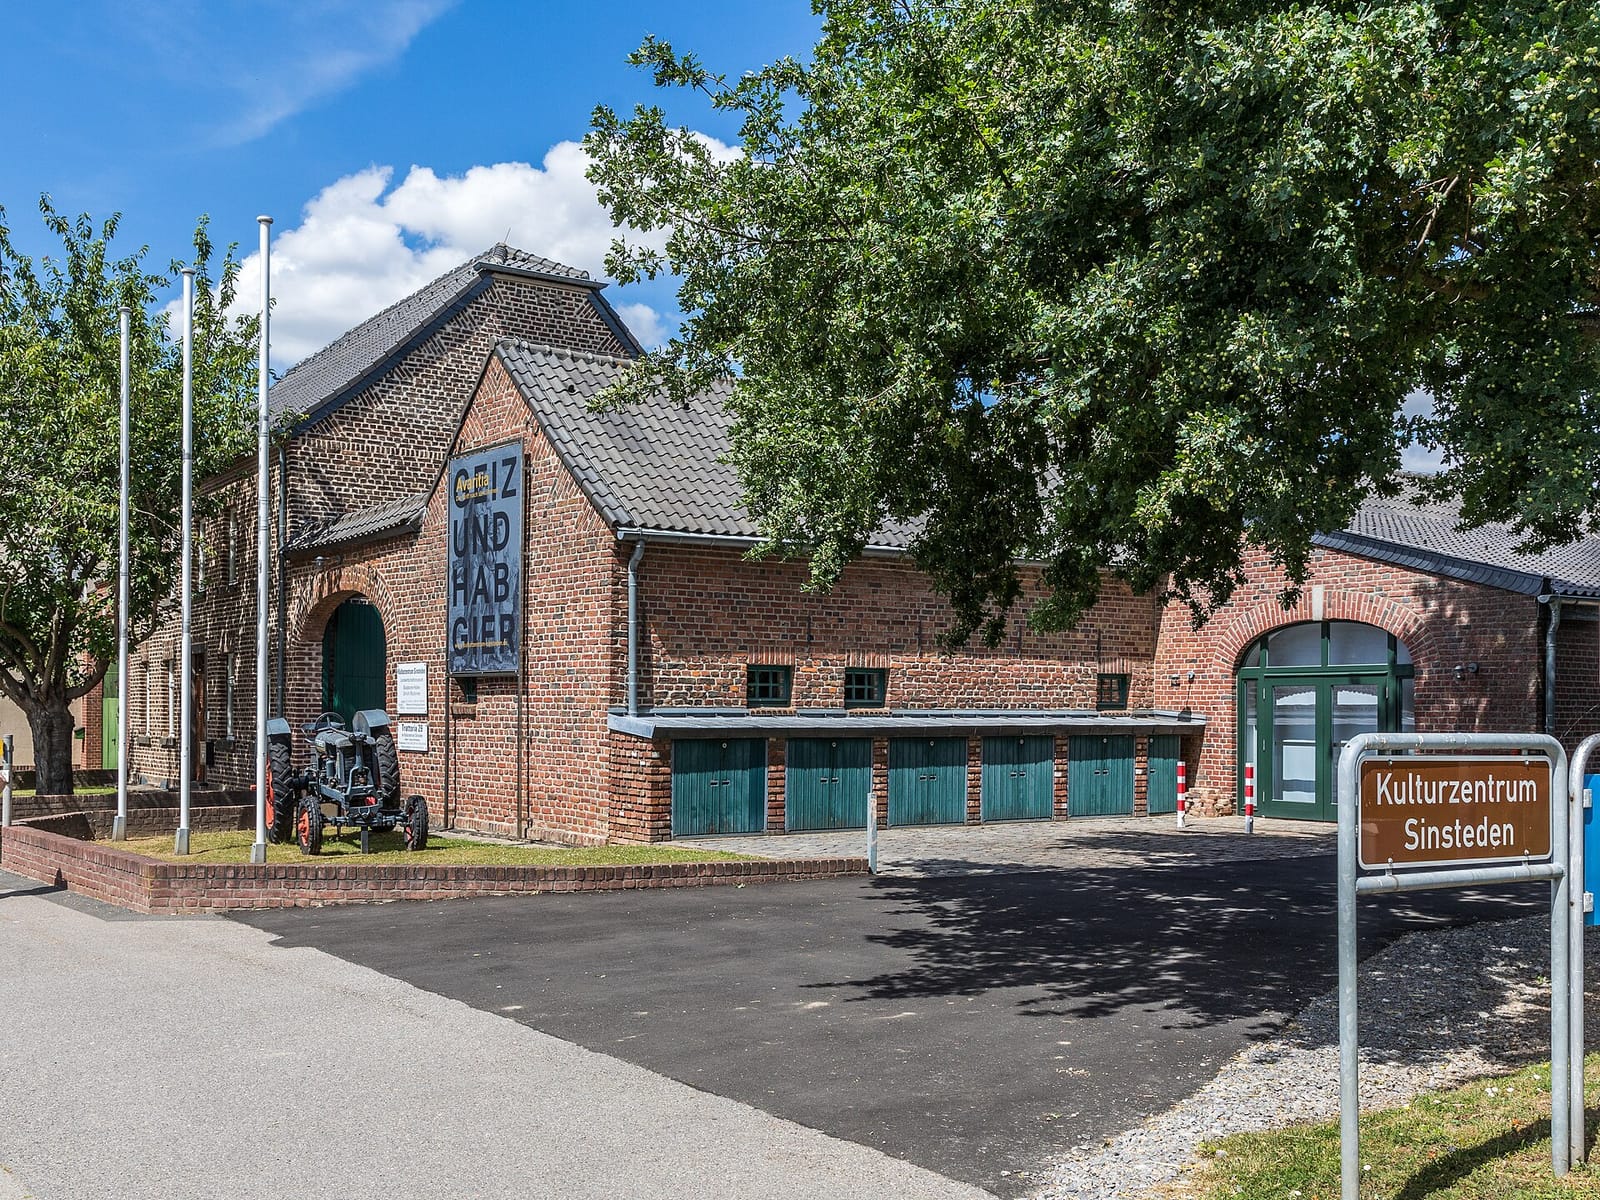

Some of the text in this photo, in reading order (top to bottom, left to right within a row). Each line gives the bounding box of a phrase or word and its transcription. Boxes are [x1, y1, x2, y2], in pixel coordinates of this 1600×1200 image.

[456, 472, 489, 492] Avaritia
[453, 512, 510, 558] UND
[452, 562, 510, 607] HAB
[452, 614, 516, 656] GIER
[1376, 772, 1538, 806] Kulturzentrum
[1404, 816, 1515, 851] Sinsteden
